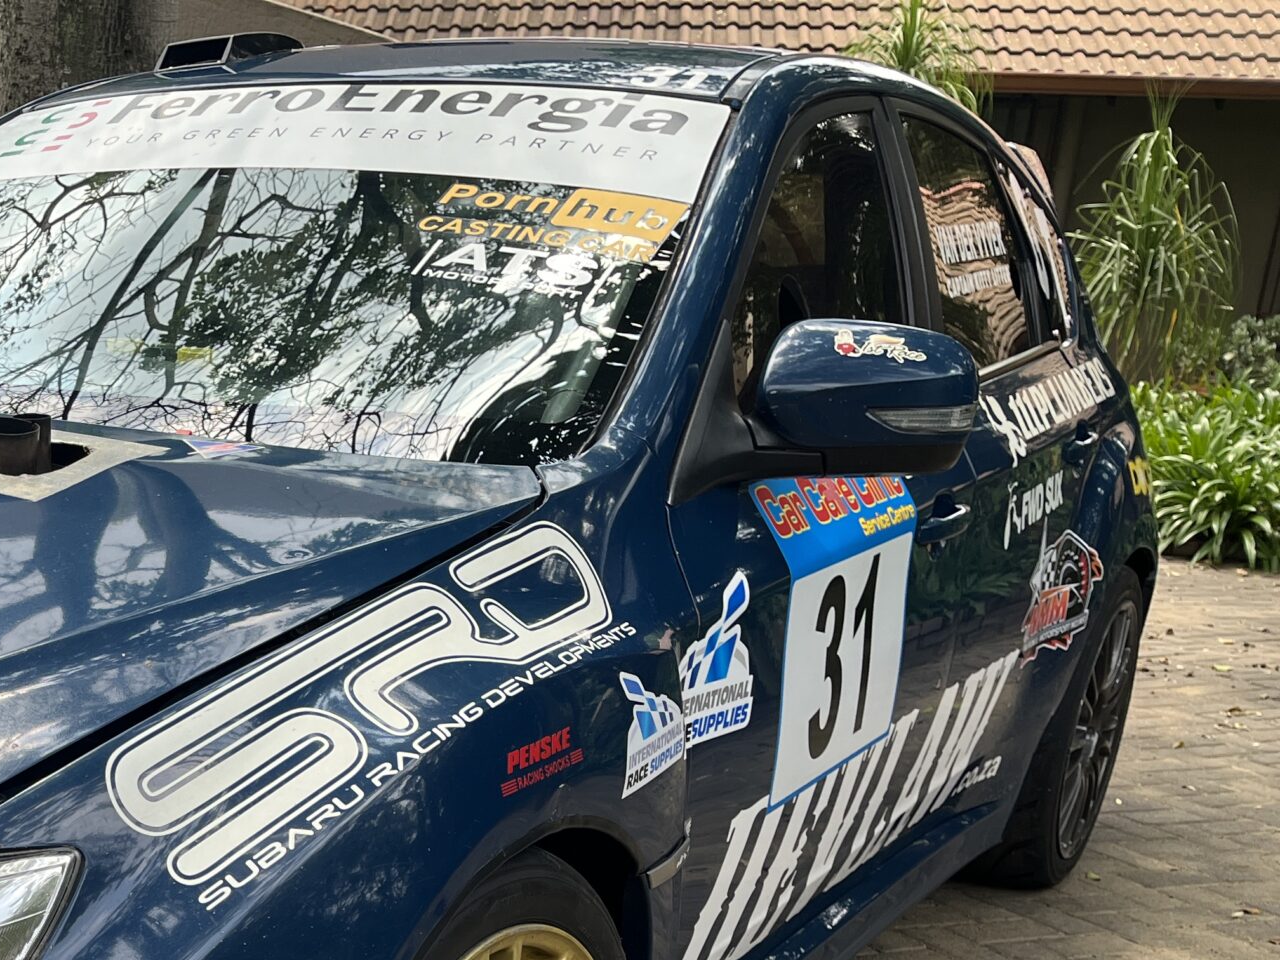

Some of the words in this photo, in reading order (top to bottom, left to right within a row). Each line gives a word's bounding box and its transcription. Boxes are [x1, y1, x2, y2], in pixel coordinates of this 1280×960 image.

[629, 65, 710, 90] 31
[85, 131, 164, 148] YOUR
[182, 127, 289, 142] GREEN
[308, 126, 453, 142] ENERGY
[475, 133, 659, 162] PARTNER
[418, 215, 573, 247] CASTING
[577, 236, 659, 264] CAR
[422, 268, 583, 298] MOTORPORT
[430, 242, 600, 287] ATS
[754, 484, 811, 539] Car
[858, 512, 891, 537] Service
[886, 503, 916, 525] Centre
[1021, 482, 1045, 531] FWD
[807, 552, 881, 761] 31
[104, 520, 614, 887] SRD
[692, 703, 750, 740] SUPPLIES
[198, 783, 365, 911] SUBARU
[366, 702, 485, 788] RACING
[480, 621, 637, 709] DEVELOPMENTS
[507, 726, 571, 775] PENSKE
[626, 762, 649, 791] RACE
[649, 739, 683, 775] SUPPLIES
[628, 724, 683, 771] INTERNATIONAL
[517, 767, 545, 790] RACING
[544, 754, 571, 778] SHOCKS
